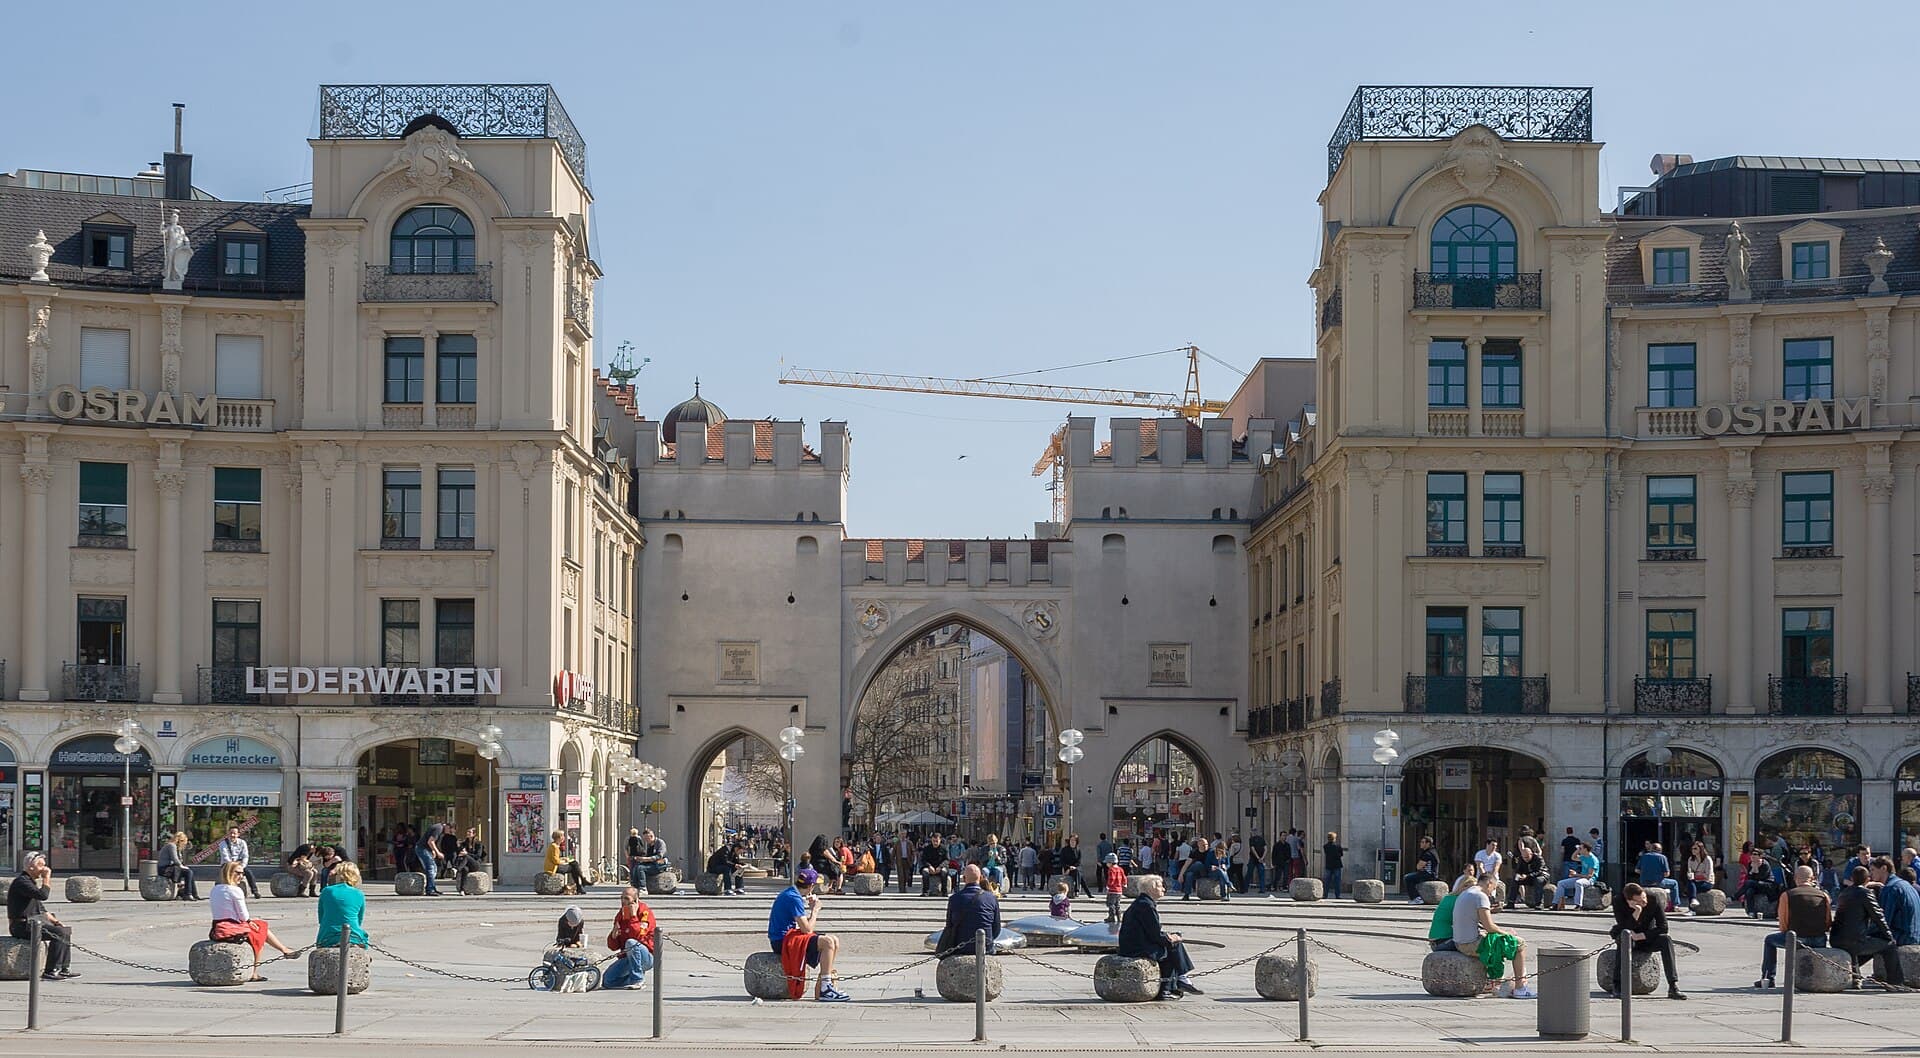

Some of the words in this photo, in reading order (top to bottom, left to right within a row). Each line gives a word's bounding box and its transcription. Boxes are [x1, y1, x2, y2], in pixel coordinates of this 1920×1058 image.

[49, 384, 218, 427] OSRAM
[1697, 396, 1871, 436] OSRAM
[246, 666, 502, 695] LEDERWAREN
[192, 754, 276, 765] Hetzenecker
[1624, 779, 1720, 791] McDonald's
[185, 793, 269, 806] Lederwaren
[1046, 804, 1056, 816] U
[1046, 819, 1056, 829] S
